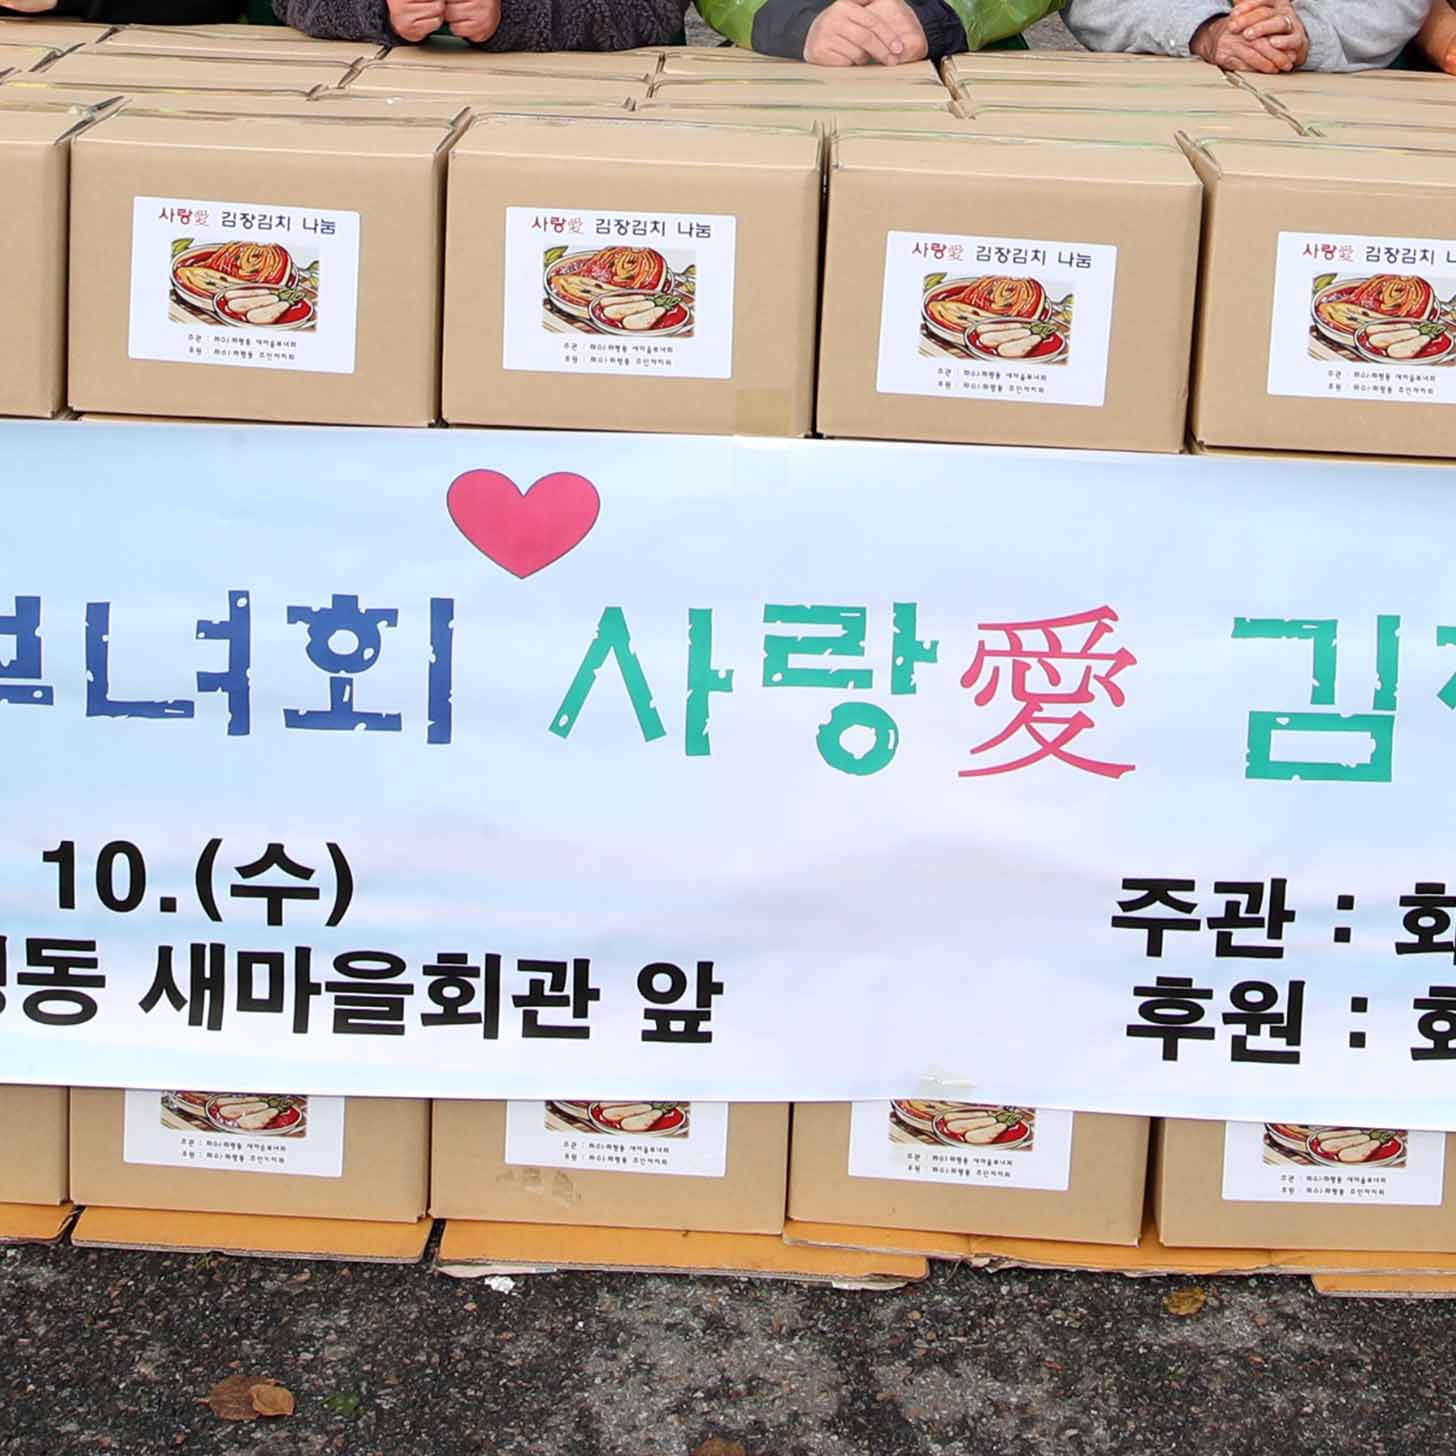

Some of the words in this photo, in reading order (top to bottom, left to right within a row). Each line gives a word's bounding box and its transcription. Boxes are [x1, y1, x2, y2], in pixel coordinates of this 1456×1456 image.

[221, 210, 291, 233] 김장김치
[302, 216, 337, 236] 나눔
[595, 218, 666, 238] 김장김치
[677, 221, 712, 239] 나눔
[975, 245, 1047, 266] 김장김치
[1057, 251, 1092, 269] 나눔
[1365, 245, 1435, 265] 김장김치
[548, 601, 1138, 780] 사랑愛
[1110, 877, 1296, 960] 주관
[139, 940, 600, 1041] 새마을회관
[636, 957, 727, 1045] 앞
[1125, 975, 1304, 1066] 후원
